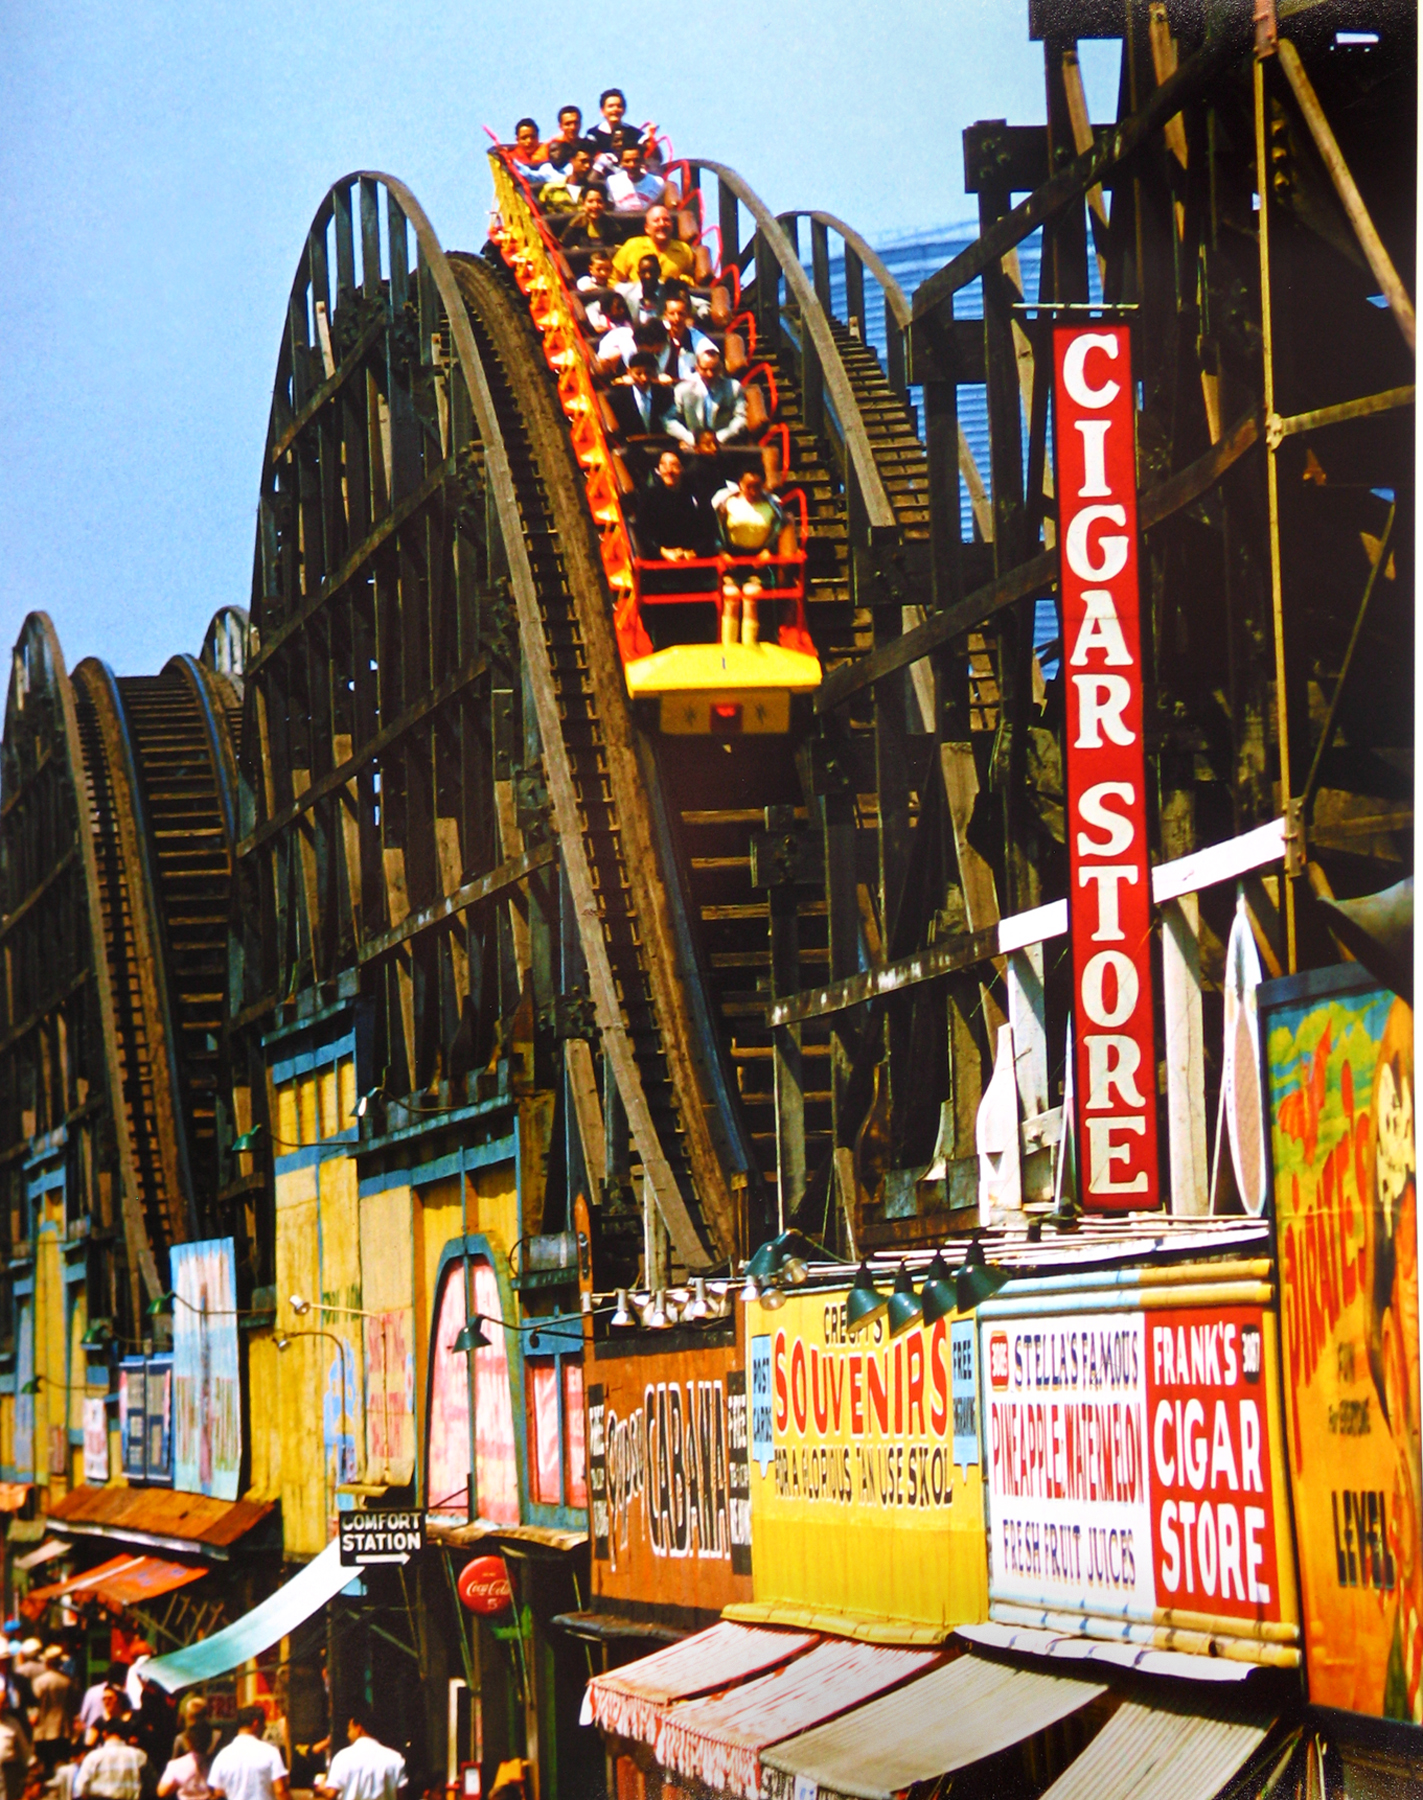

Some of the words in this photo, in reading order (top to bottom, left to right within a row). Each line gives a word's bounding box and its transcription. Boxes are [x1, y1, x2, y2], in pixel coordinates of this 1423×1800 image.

[1062, 333, 1136, 749] CIGAR
[1076, 781, 1149, 1194] STORE
[774, 1316, 948, 1437] SOUVENIRS
[952, 1339, 972, 1380] FREE
[1014, 1331, 1079, 1389] STELLA'S
[1081, 1330, 1138, 1390] FAMOUS
[1152, 1320, 1237, 1385] FRANK'S
[645, 1379, 731, 1561] CABANA
[774, 1447, 791, 1498] FOR
[792, 1447, 800, 1499] A
[802, 1447, 853, 1502] GLORIOUS
[877, 1446, 904, 1506] USE
[907, 1445, 953, 1508] SKOL
[991, 1402, 1062, 1499] PINEAPPLE
[1064, 1402, 1144, 1504] WATERMELON
[1153, 1398, 1264, 1492] CIGAR
[342, 1513, 421, 1532] COMFORT
[342, 1532, 421, 1552] STATION
[1002, 1519, 1041, 1577] FRESH
[1043, 1522, 1081, 1582] FRUIT
[1087, 1526, 1136, 1589] JUICES
[1159, 1499, 1271, 1604] STORE
[1332, 1490, 1395, 1588] LEVEL
